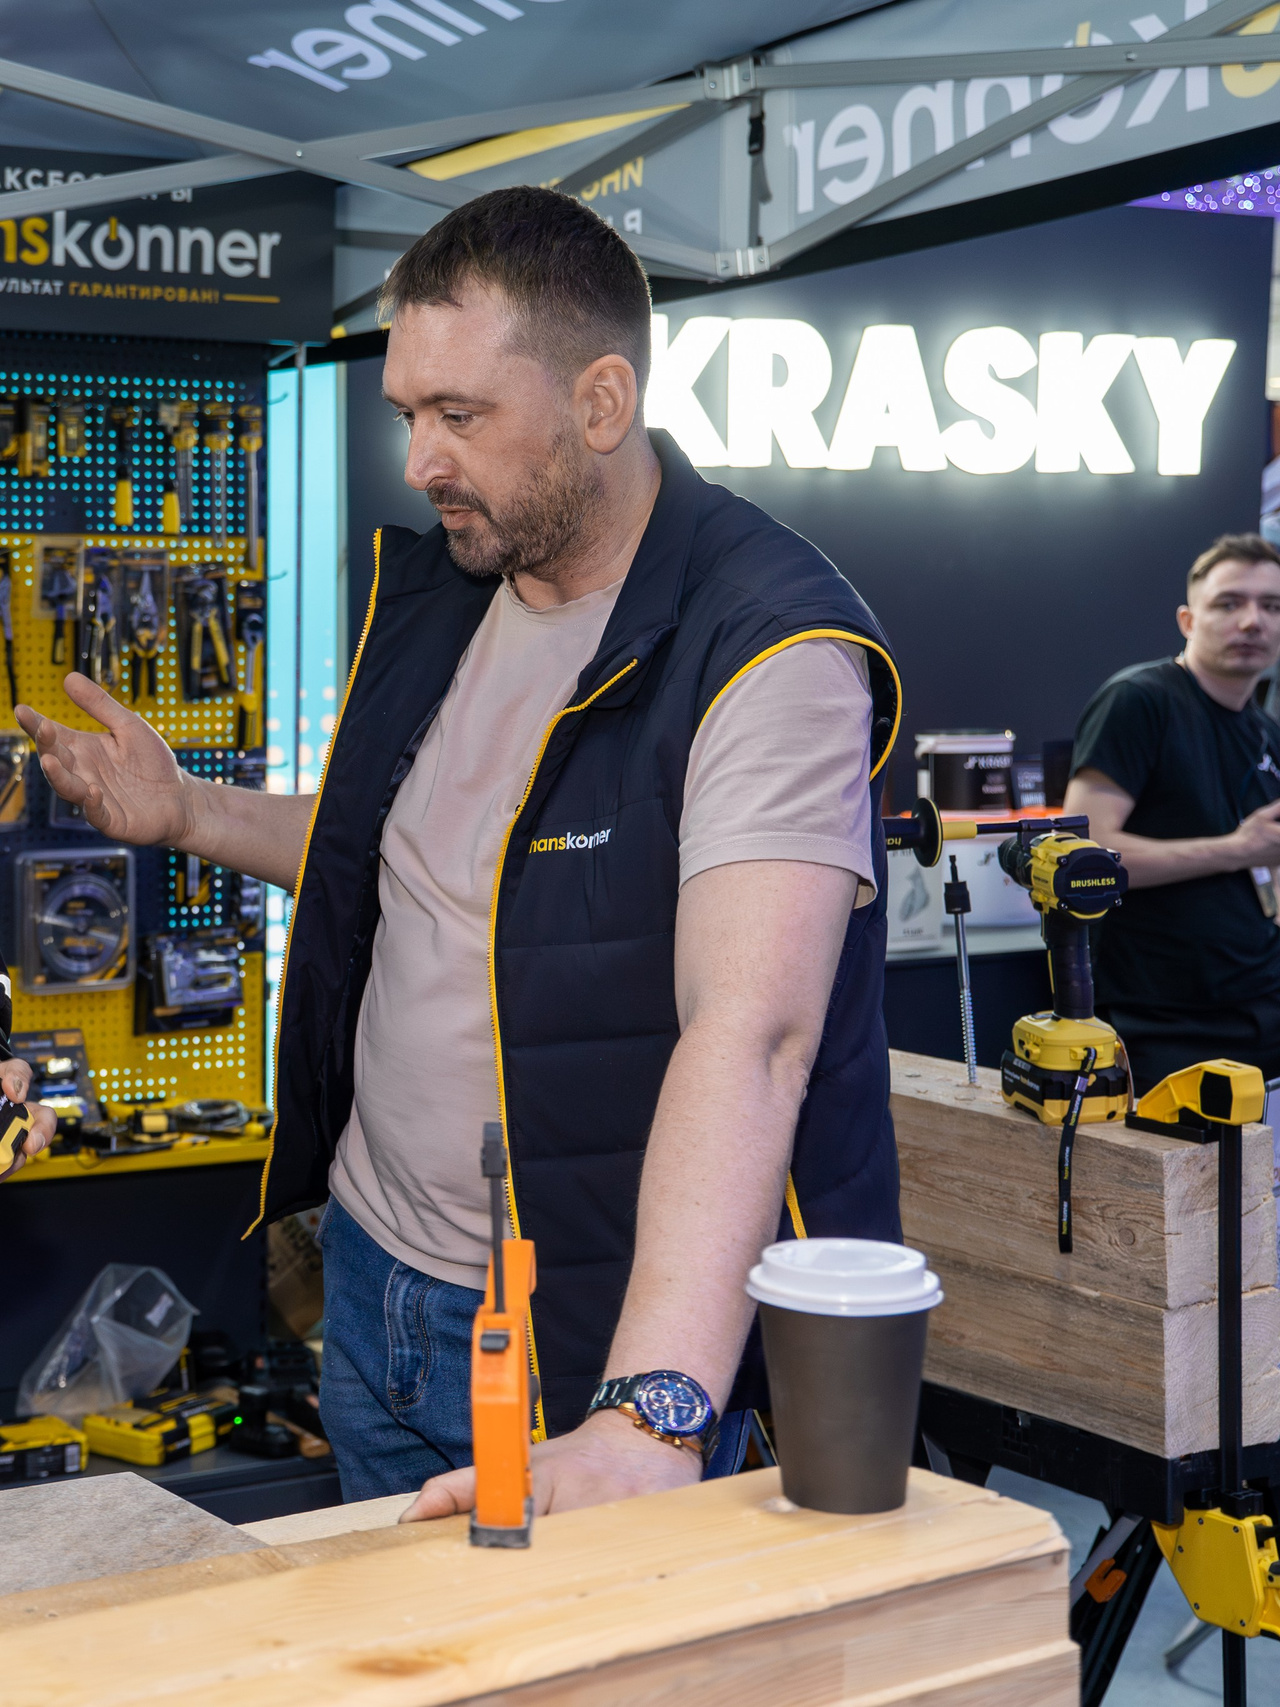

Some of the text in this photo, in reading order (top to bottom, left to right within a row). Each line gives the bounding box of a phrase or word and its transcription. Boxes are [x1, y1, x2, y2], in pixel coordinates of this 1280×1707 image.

[68, 281, 219, 304] ГАРАНТИРОВАН!
[650, 314, 1237, 476] KRASKY
[1070, 877, 1116, 889] BRUSHLESS
